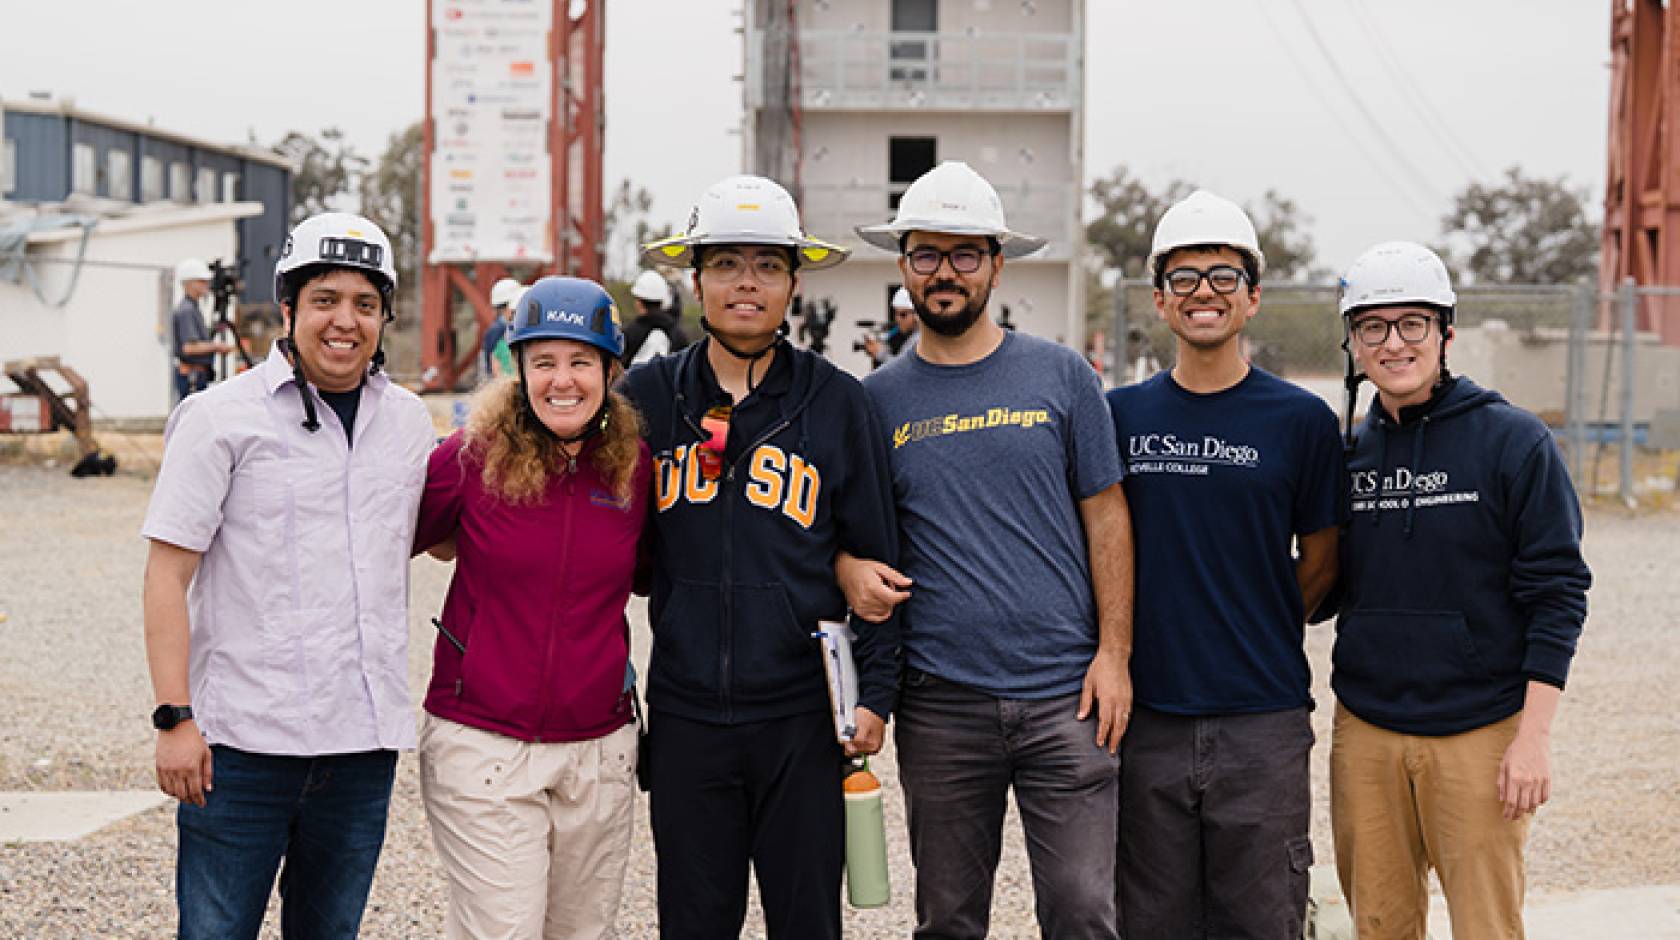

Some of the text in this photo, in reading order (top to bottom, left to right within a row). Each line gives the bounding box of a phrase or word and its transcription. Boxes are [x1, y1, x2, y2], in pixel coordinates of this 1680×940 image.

[546, 310, 584, 326] KASK
[1129, 433, 1258, 465] UC San Diego
[1396, 467, 1448, 491] Dego
